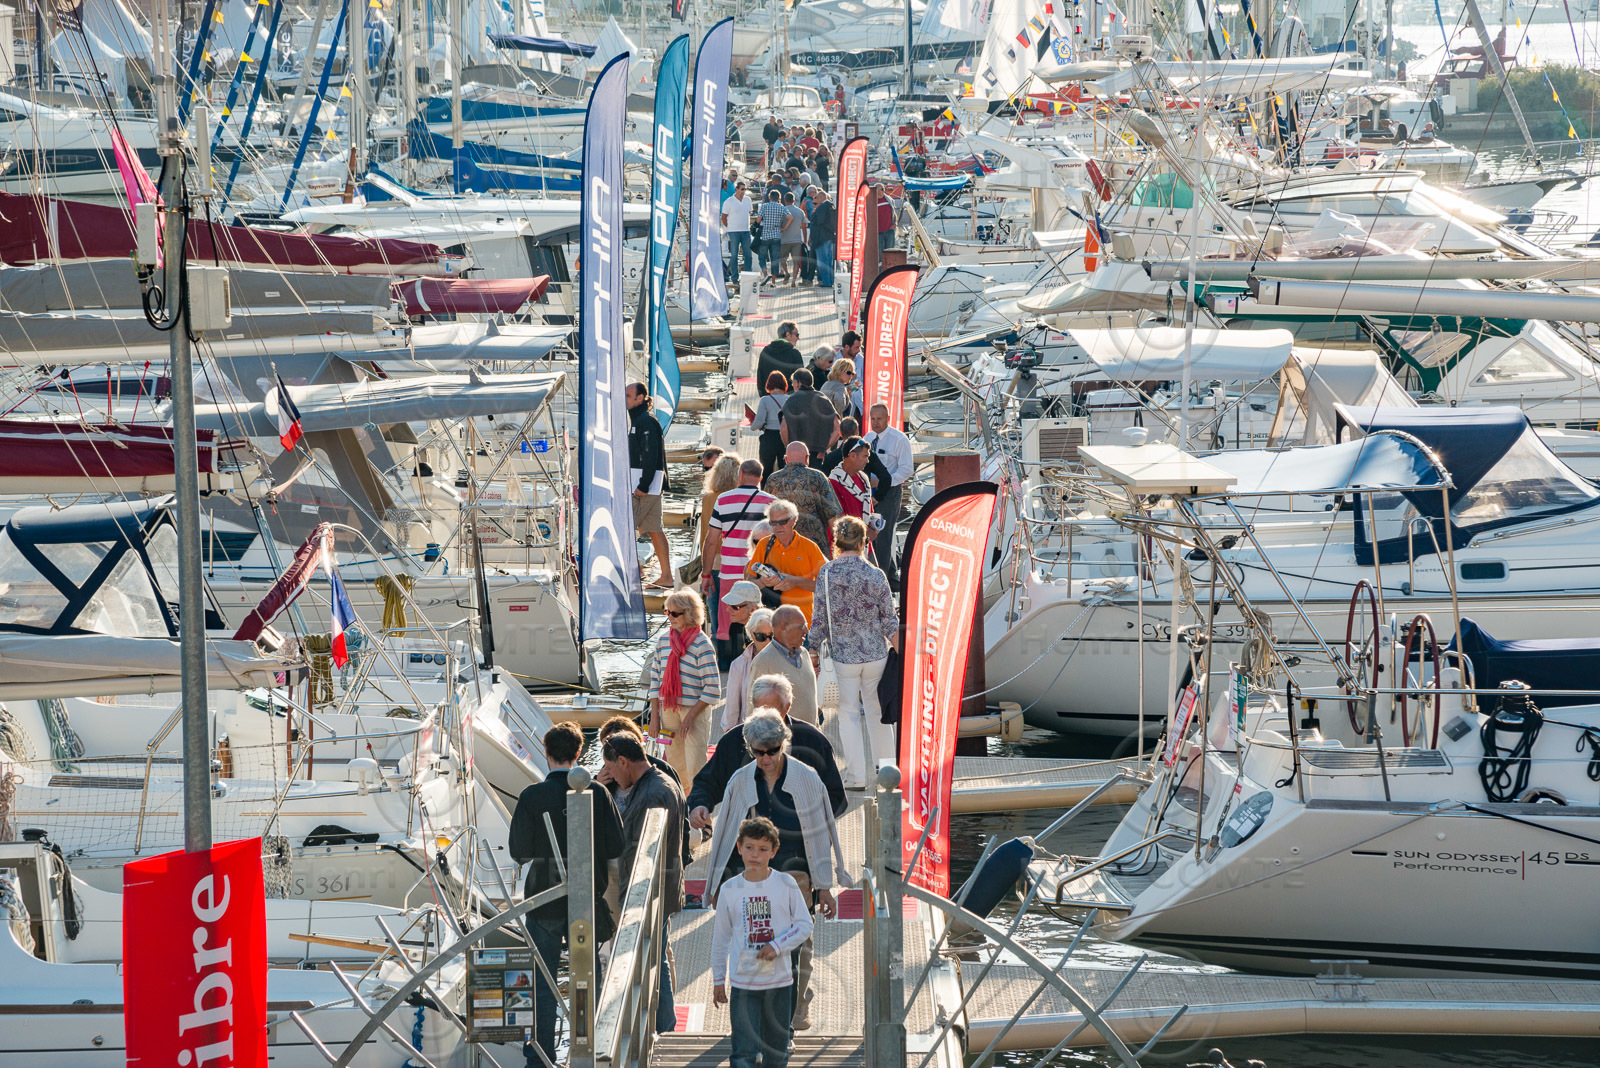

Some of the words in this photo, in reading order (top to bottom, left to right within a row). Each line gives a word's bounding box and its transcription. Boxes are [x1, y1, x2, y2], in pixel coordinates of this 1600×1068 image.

[1067, 131, 1093, 140] Caprice
[848, 159, 857, 191] DIRECT
[880, 283, 906, 296] CARNON
[879, 303, 893, 357] DIRECT
[876, 370, 891, 404] TING
[930, 517, 974, 540] CARNON
[925, 553, 954, 657] DIRECT
[1393, 850, 1431, 859] SUN
[1436, 852, 1521, 864] ODYSSEY
[1528, 851, 1560, 866] 45
[1565, 851, 1590, 861] DS
[1393, 861, 1518, 875] Performance
[316, 874, 350, 894] 361
[747, 902, 768, 914] RACE
